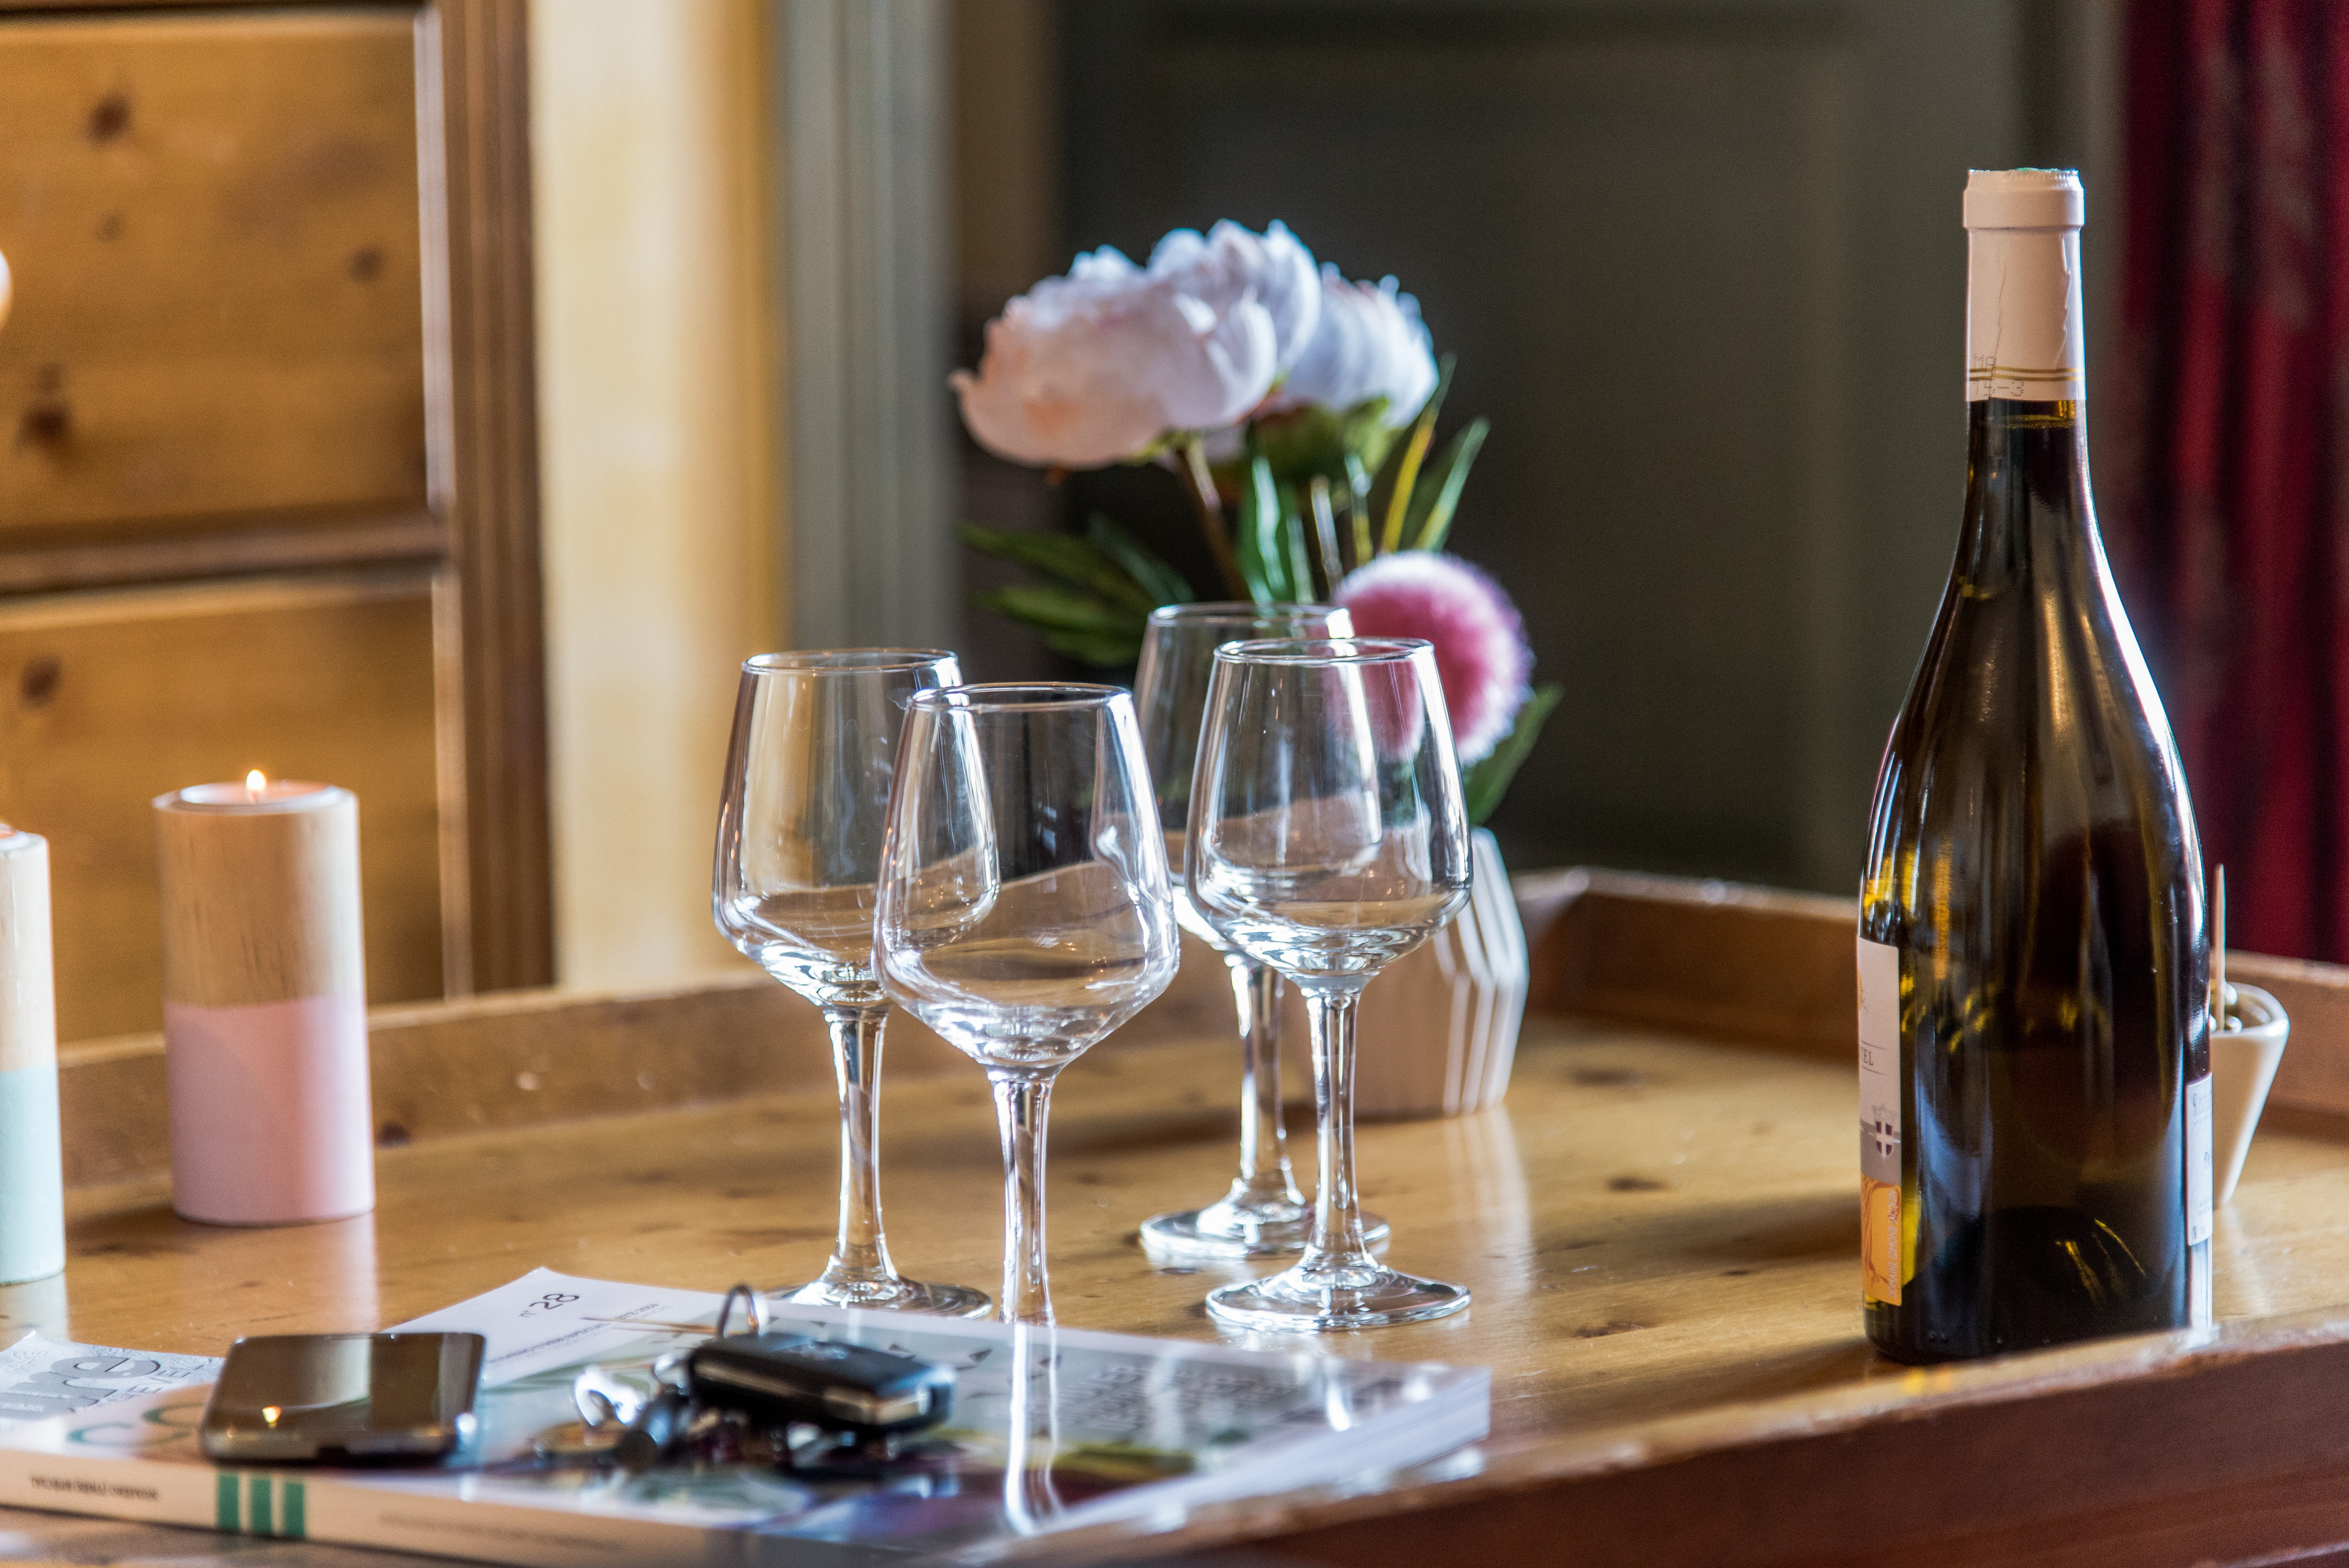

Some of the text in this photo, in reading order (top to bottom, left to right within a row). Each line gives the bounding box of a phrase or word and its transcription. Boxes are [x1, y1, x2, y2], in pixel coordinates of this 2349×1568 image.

[1888, 1226, 1898, 1260] EDMOND
[1888, 1261, 1898, 1298] DOMAINE
[529, 1293, 580, 1310] 28
